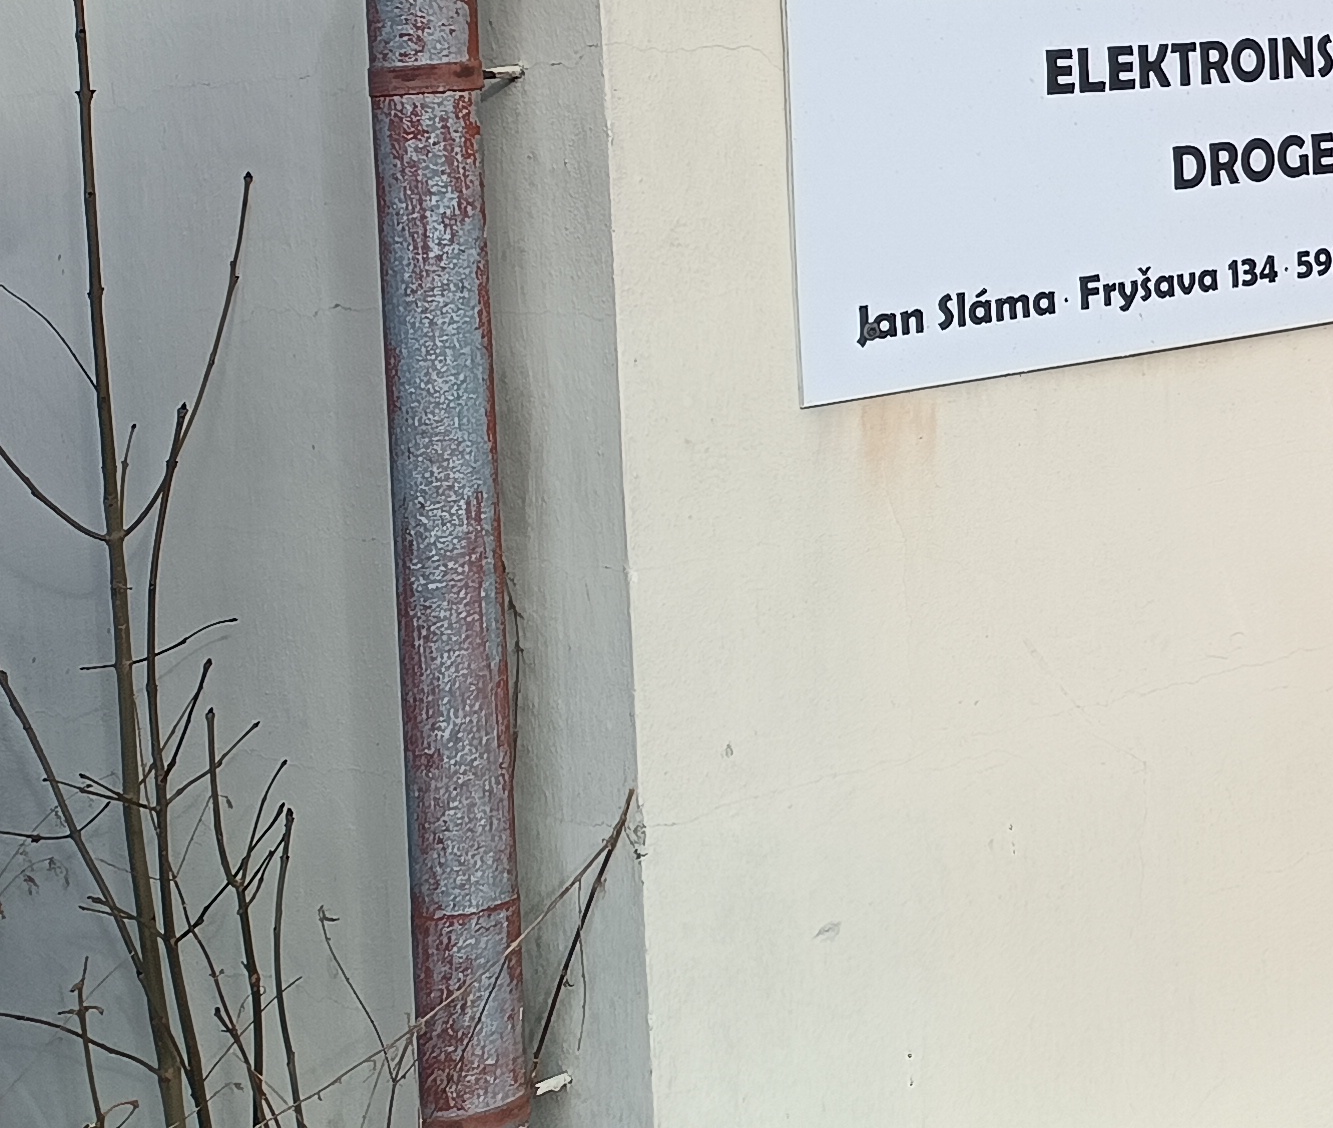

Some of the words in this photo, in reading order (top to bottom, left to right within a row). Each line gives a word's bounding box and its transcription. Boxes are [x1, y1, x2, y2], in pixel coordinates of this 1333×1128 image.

[856, 304, 925, 348] Jan
[937, 288, 1056, 332] Sláma
[1079, 265, 1219, 313] Fryšava
[1228, 254, 1279, 289] 134
